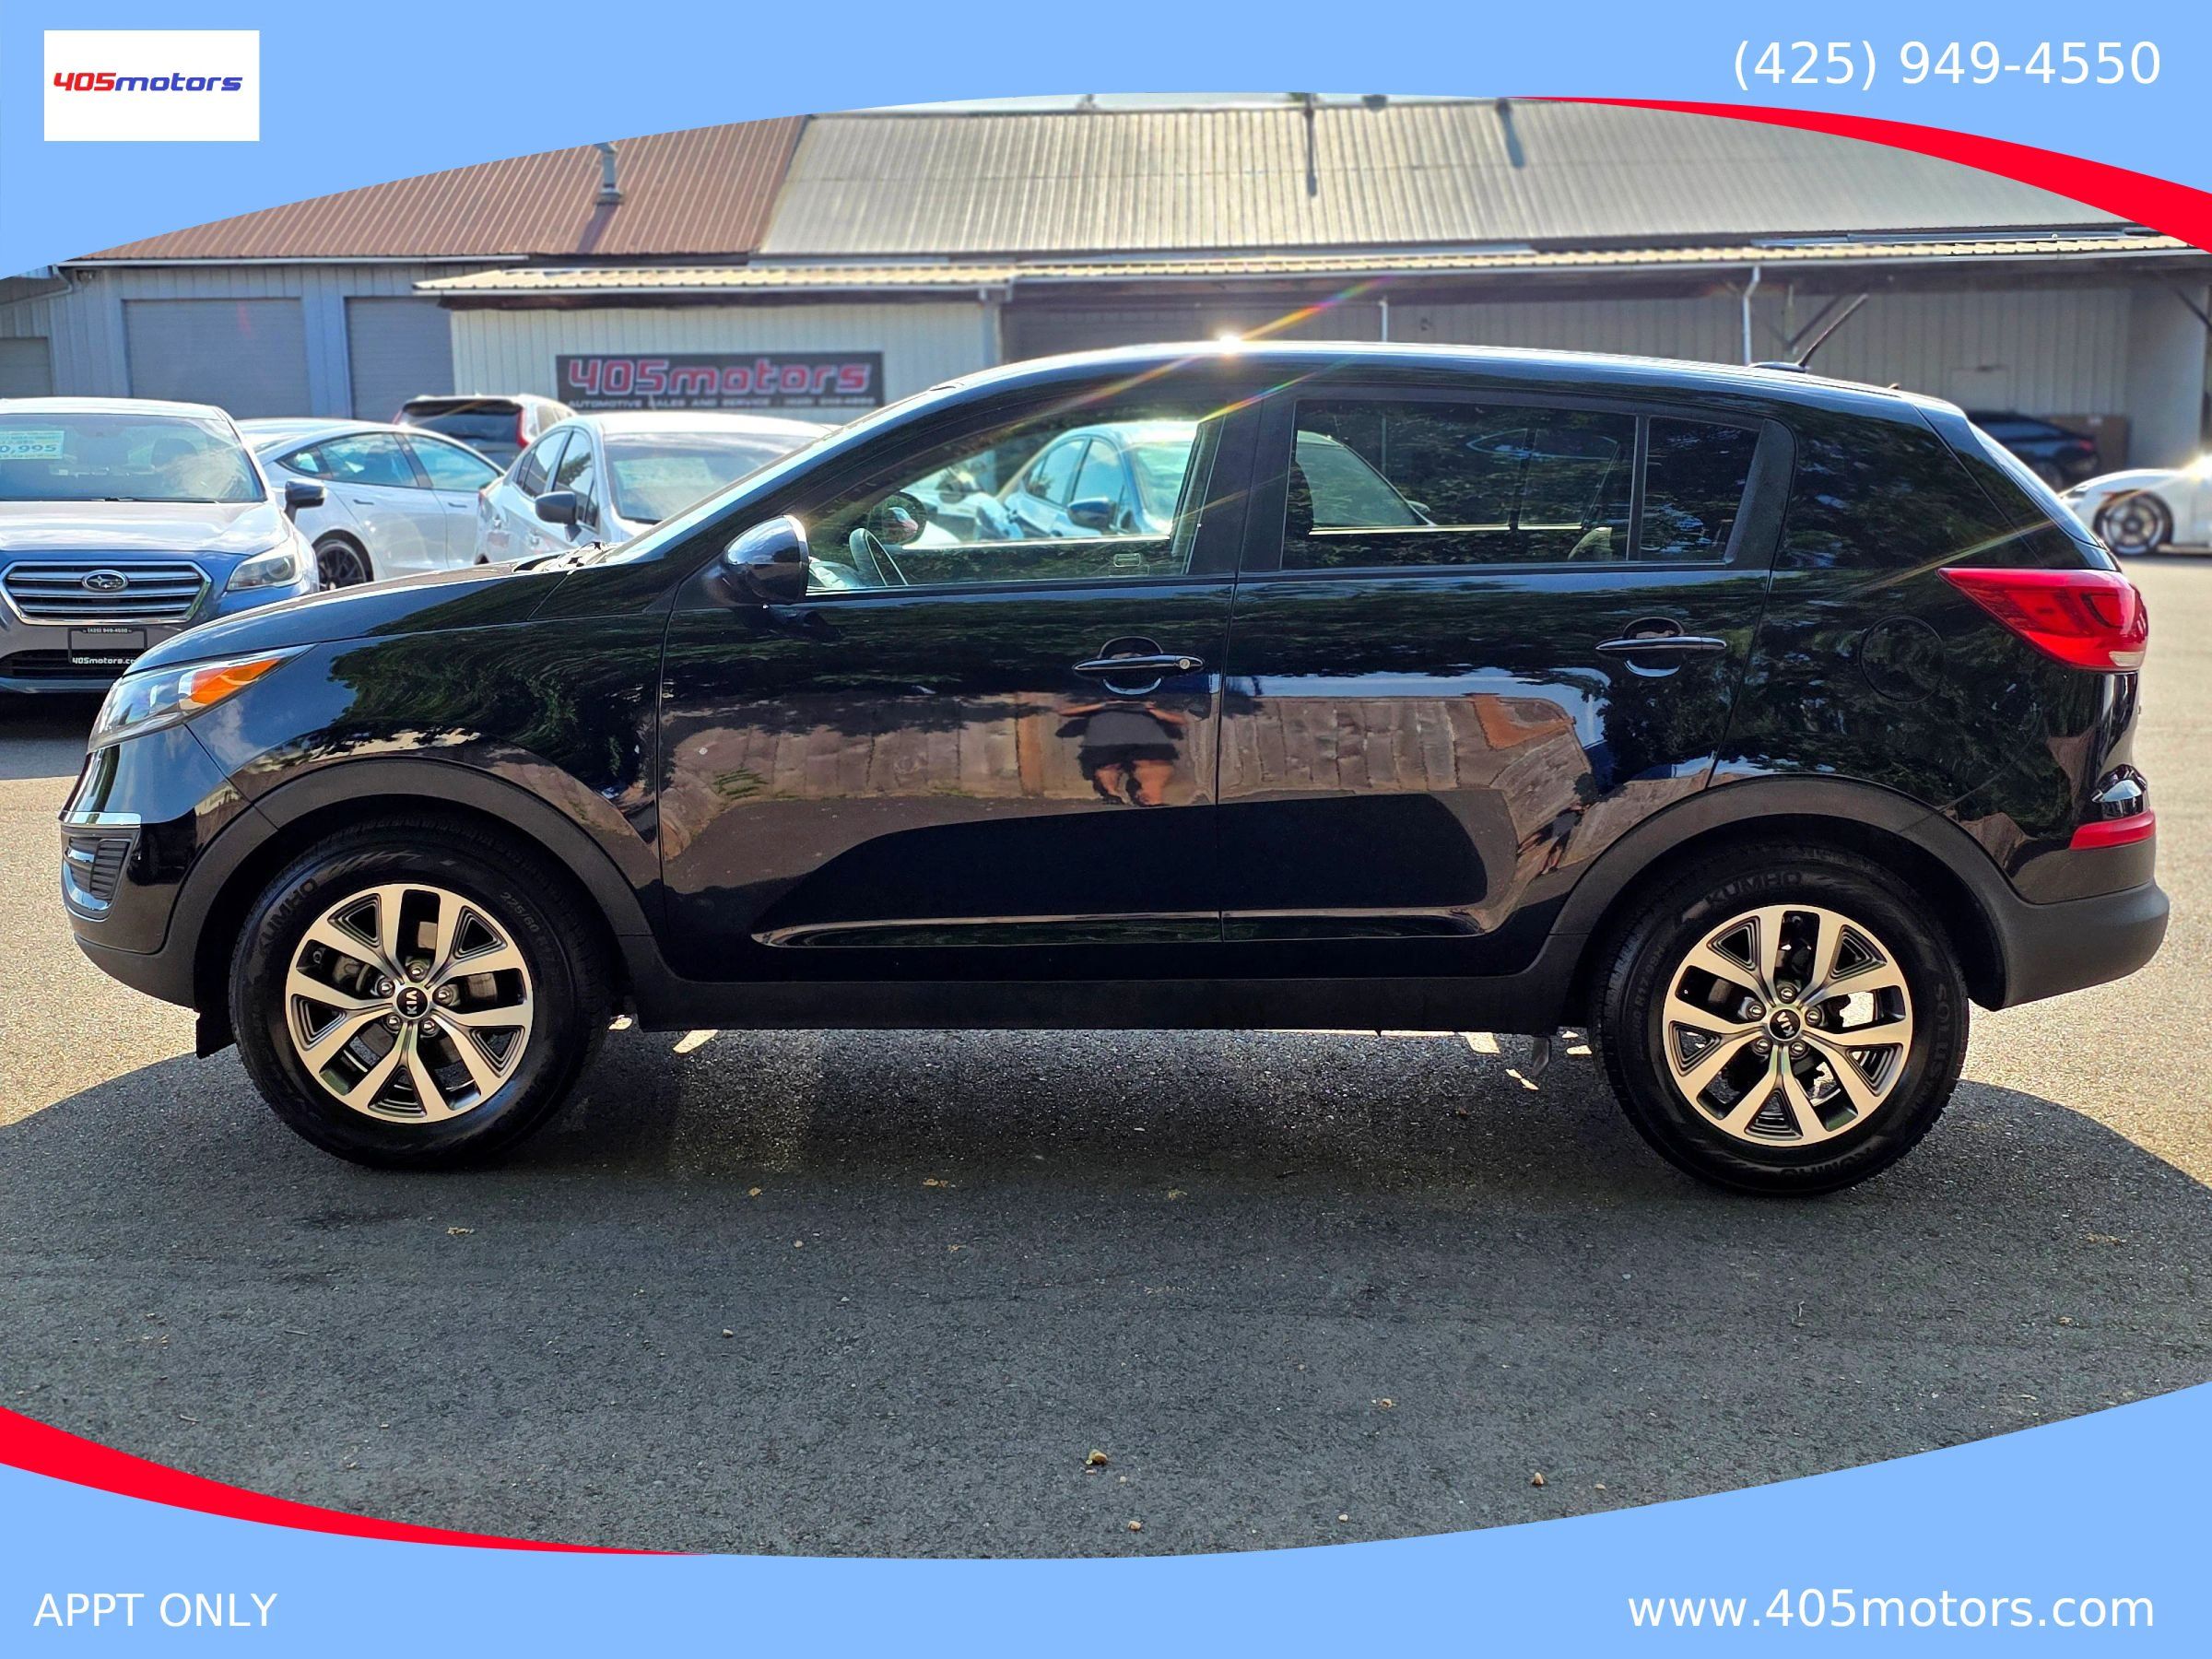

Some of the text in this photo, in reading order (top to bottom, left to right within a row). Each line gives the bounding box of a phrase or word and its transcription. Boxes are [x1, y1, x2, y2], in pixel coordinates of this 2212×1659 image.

[568, 359, 871, 396] 405motors
[568, 399, 642, 408] AUTOMOTIVE
[258, 877, 319, 951] KUMHO
[406, 990, 418, 1015] KIA
[1776, 1011, 1795, 1037] KIA
